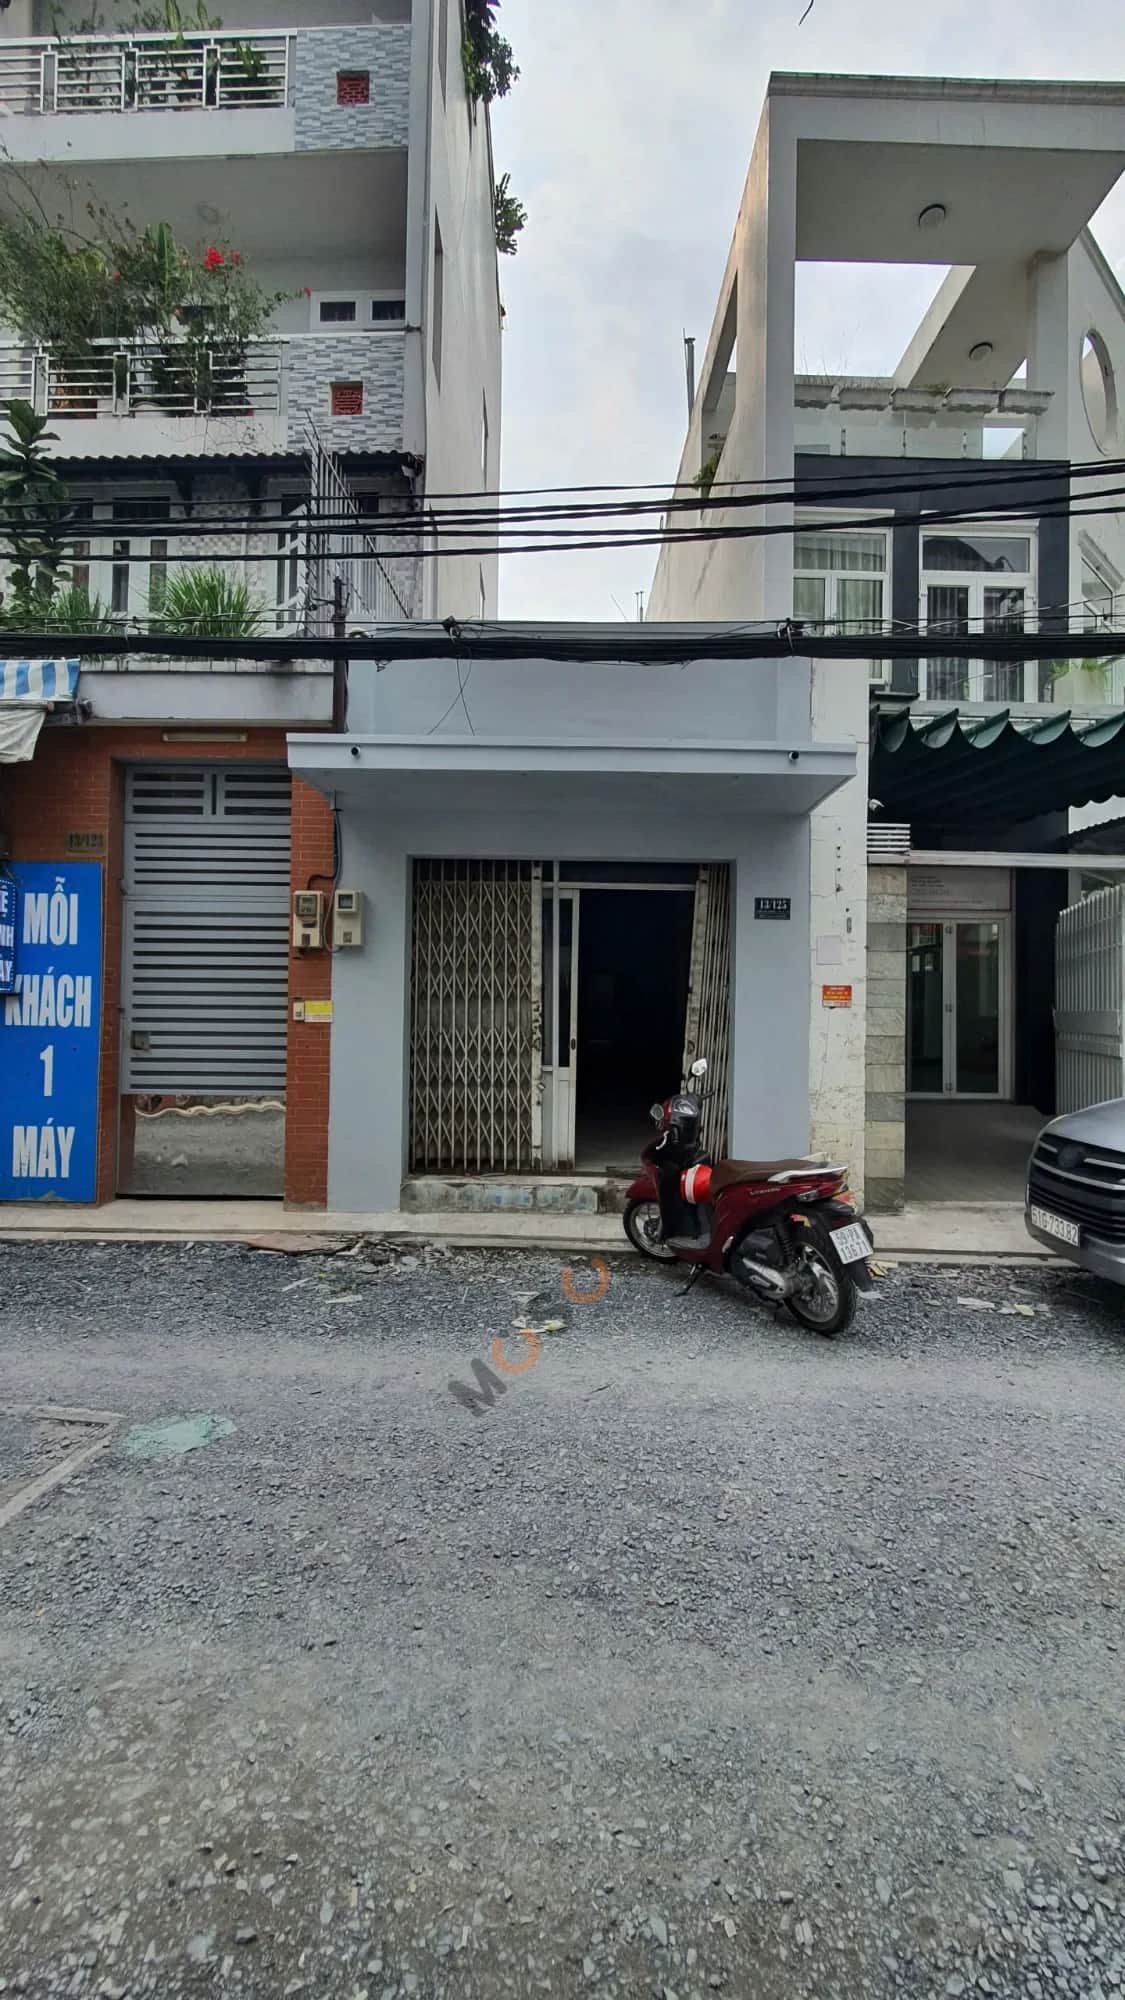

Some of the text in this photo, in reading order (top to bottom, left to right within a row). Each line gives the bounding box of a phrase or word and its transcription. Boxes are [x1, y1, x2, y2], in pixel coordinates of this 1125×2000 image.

[23, 876, 79, 946] MỖI
[760, 899, 787, 910] 13/125
[5, 966, 92, 1028] KHÁCH
[39, 1045, 54, 1097] 1
[12, 1117, 76, 1178] MÁY
